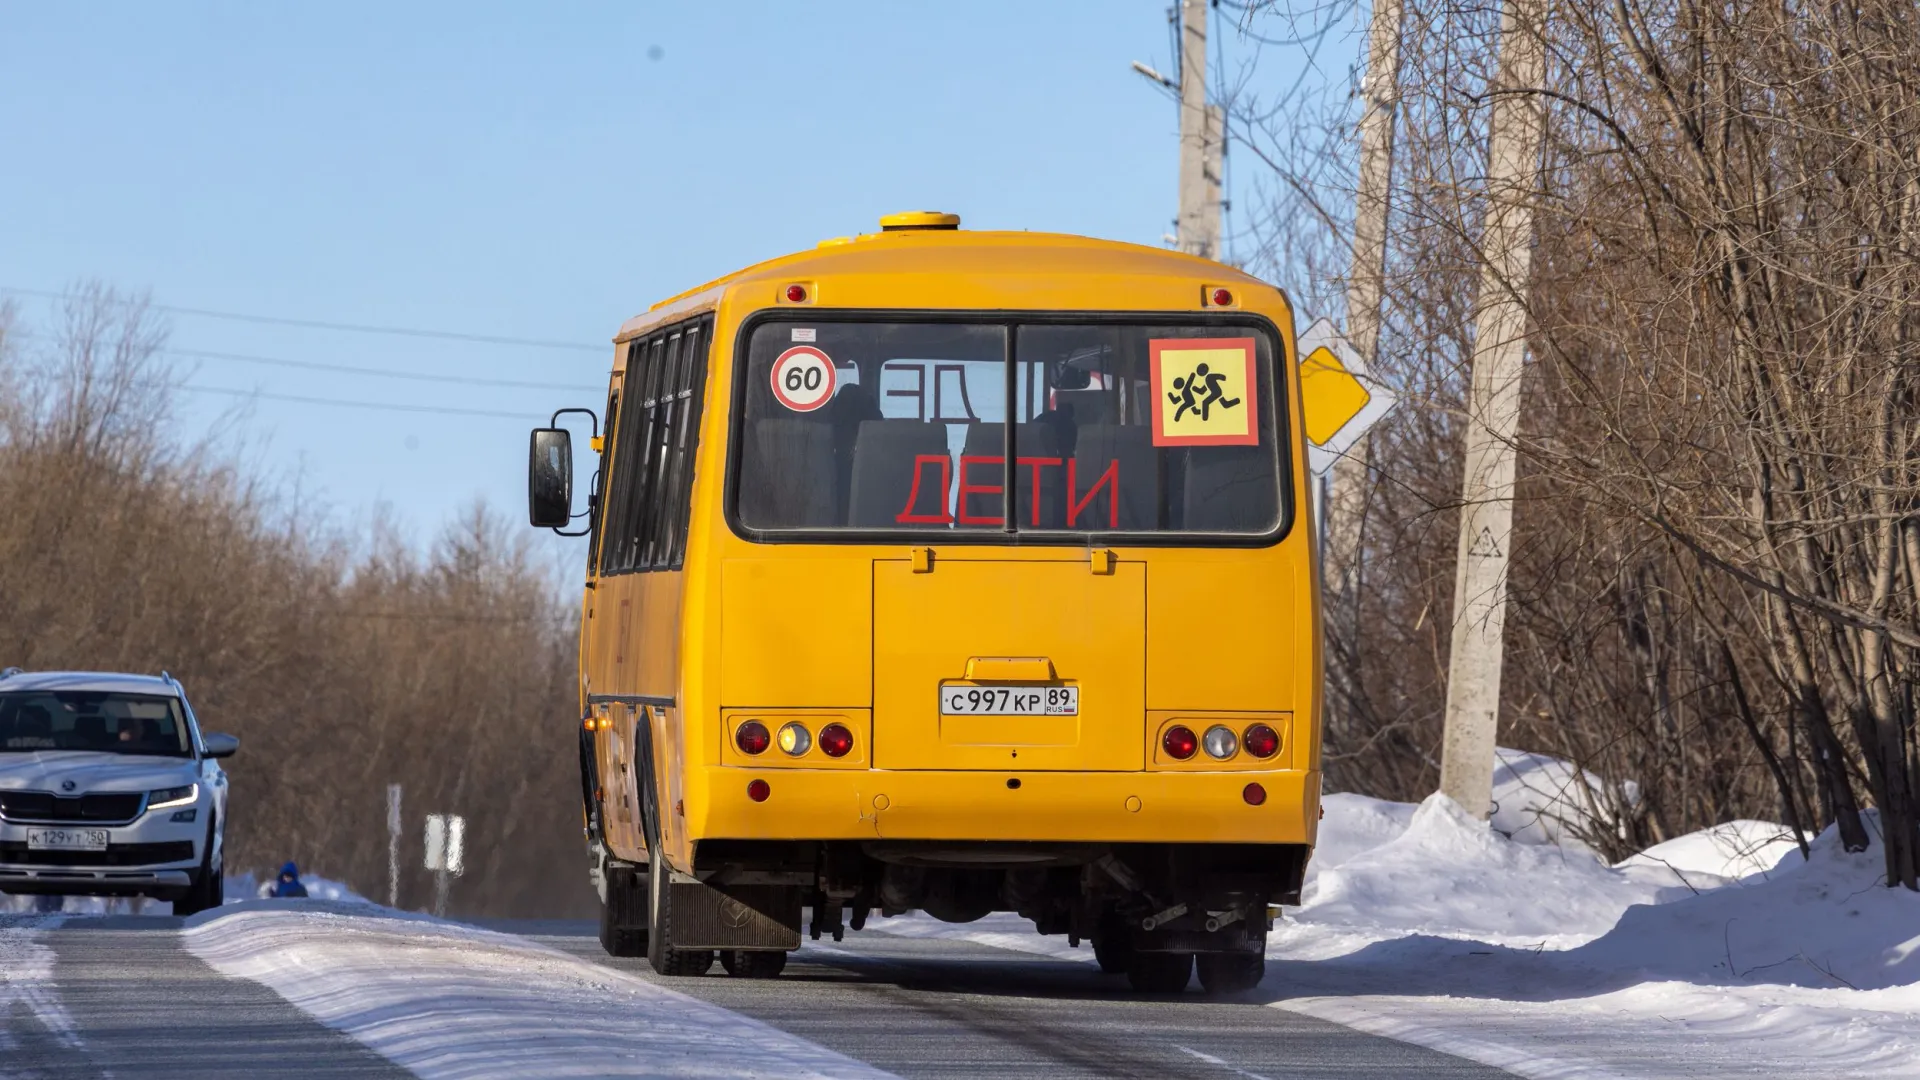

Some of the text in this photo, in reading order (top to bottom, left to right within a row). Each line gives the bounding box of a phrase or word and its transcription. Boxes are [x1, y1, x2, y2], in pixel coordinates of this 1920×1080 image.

[785, 366, 821, 391] 60
[895, 454, 1119, 528] ДЕТИ
[951, 689, 1070, 712] С997КР 89
